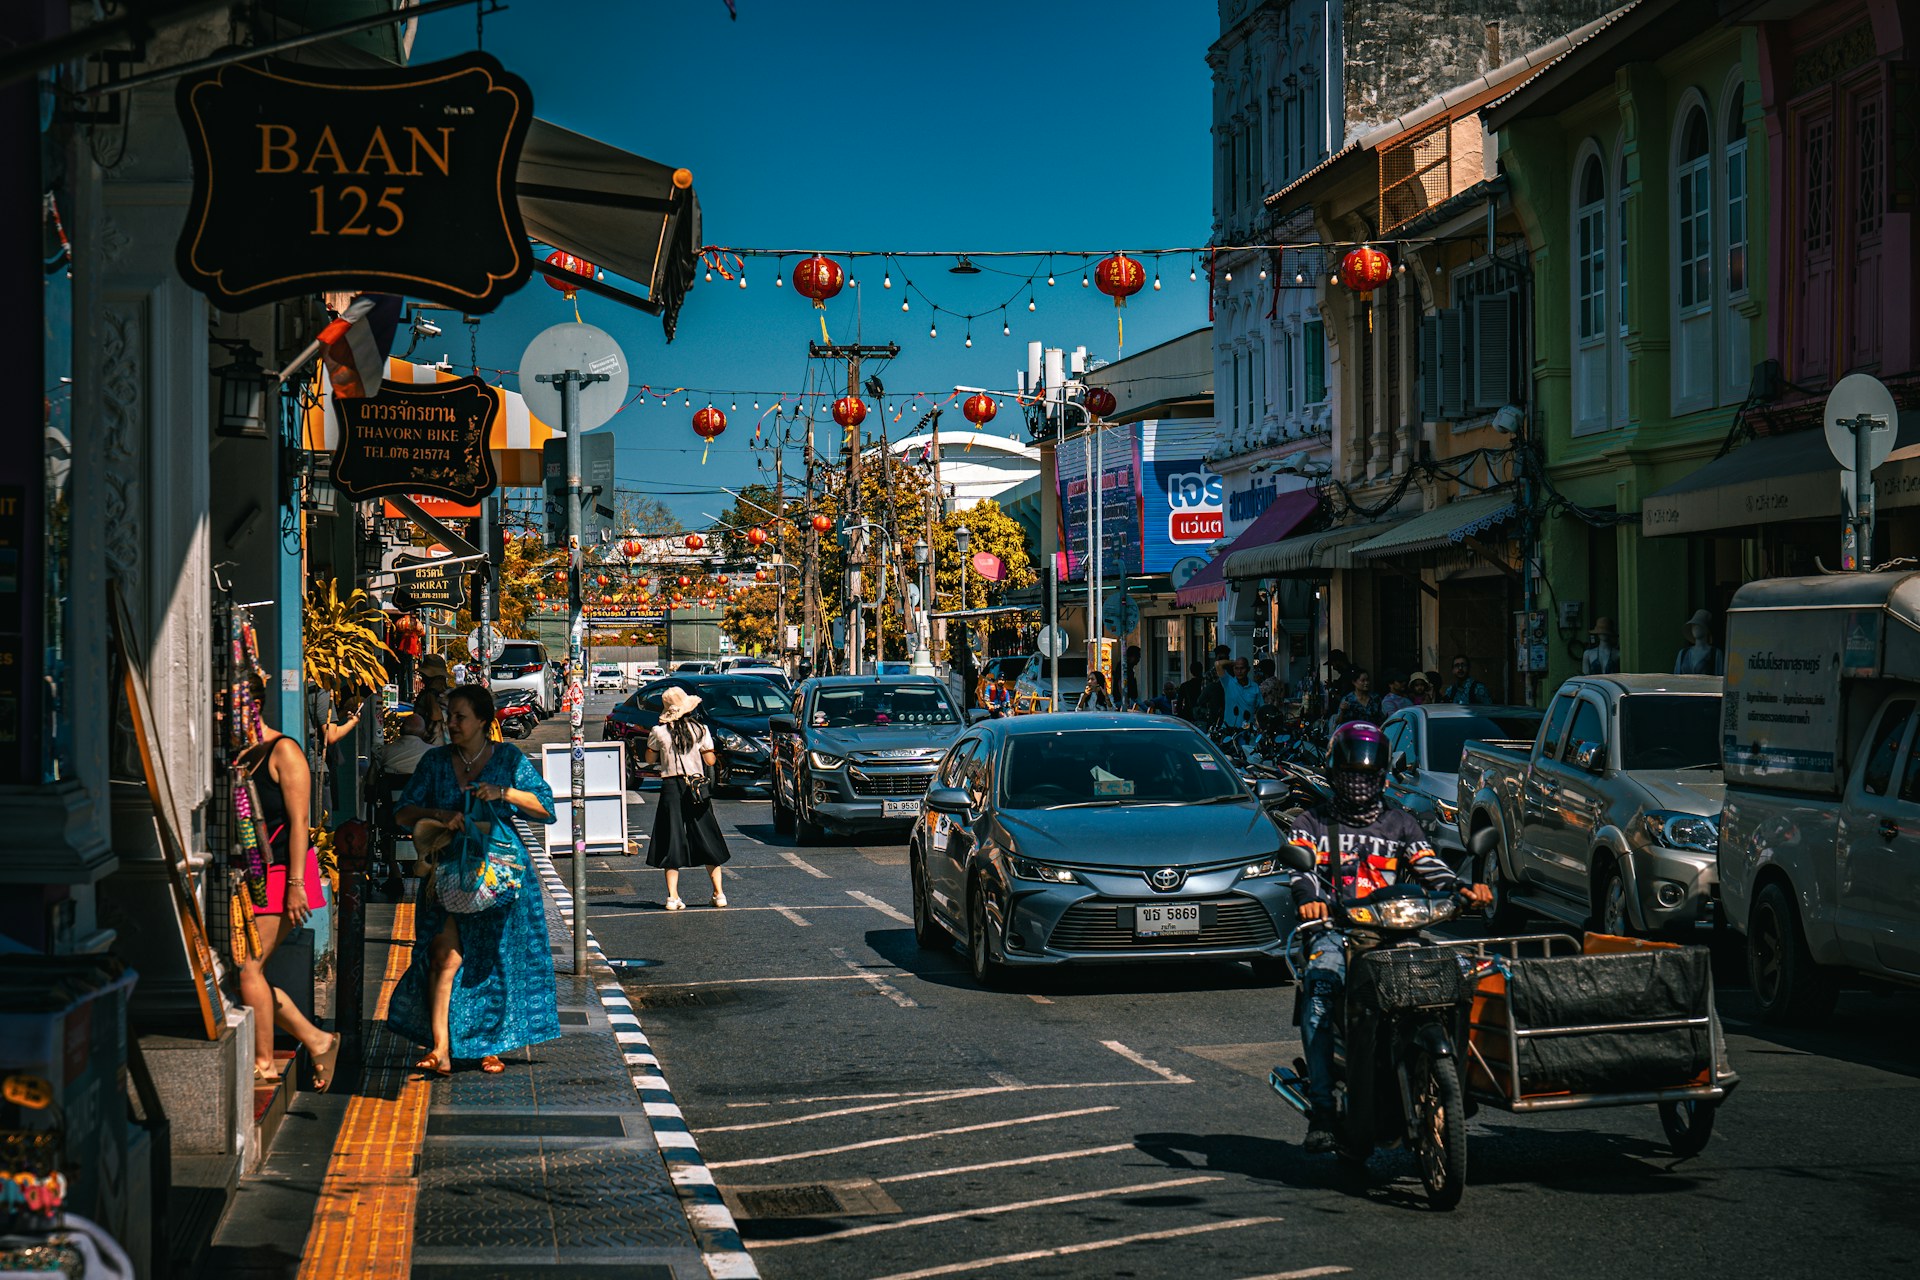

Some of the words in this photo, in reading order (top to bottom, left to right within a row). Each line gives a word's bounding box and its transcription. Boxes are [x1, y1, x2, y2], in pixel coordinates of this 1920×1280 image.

[255, 124, 455, 176] BAAN
[310, 185, 405, 236] 125
[361, 400, 456, 423] ถาวรจักรยาน
[356, 426, 423, 440] THAVORN
[427, 429, 459, 442] BIKE
[1143, 908, 1160, 920] ขธ
[1167, 907, 1197, 920] 5869
